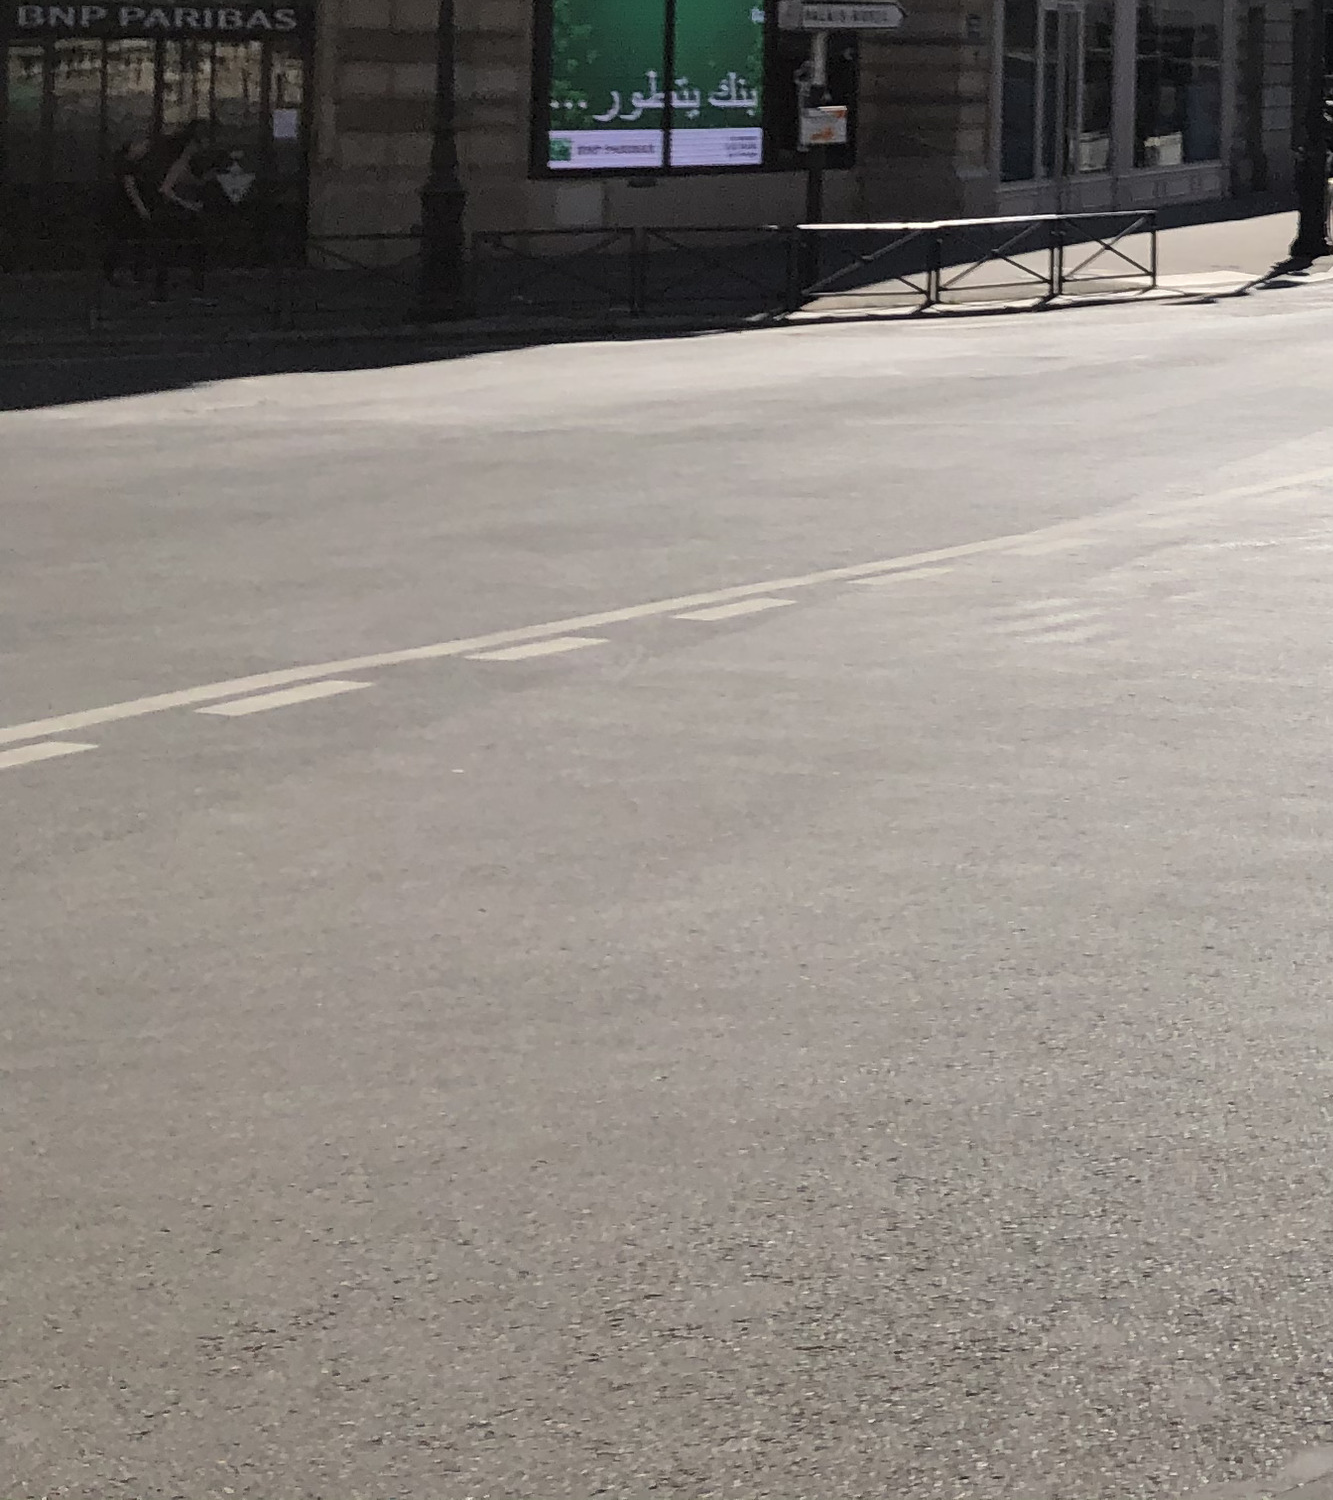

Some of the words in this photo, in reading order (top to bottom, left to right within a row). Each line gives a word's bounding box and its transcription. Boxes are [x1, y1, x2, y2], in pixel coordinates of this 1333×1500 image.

[17, 5, 108, 28] BNP
[118, 6, 298, 31] PARIBAS
[708, 71, 759, 118] بنك
